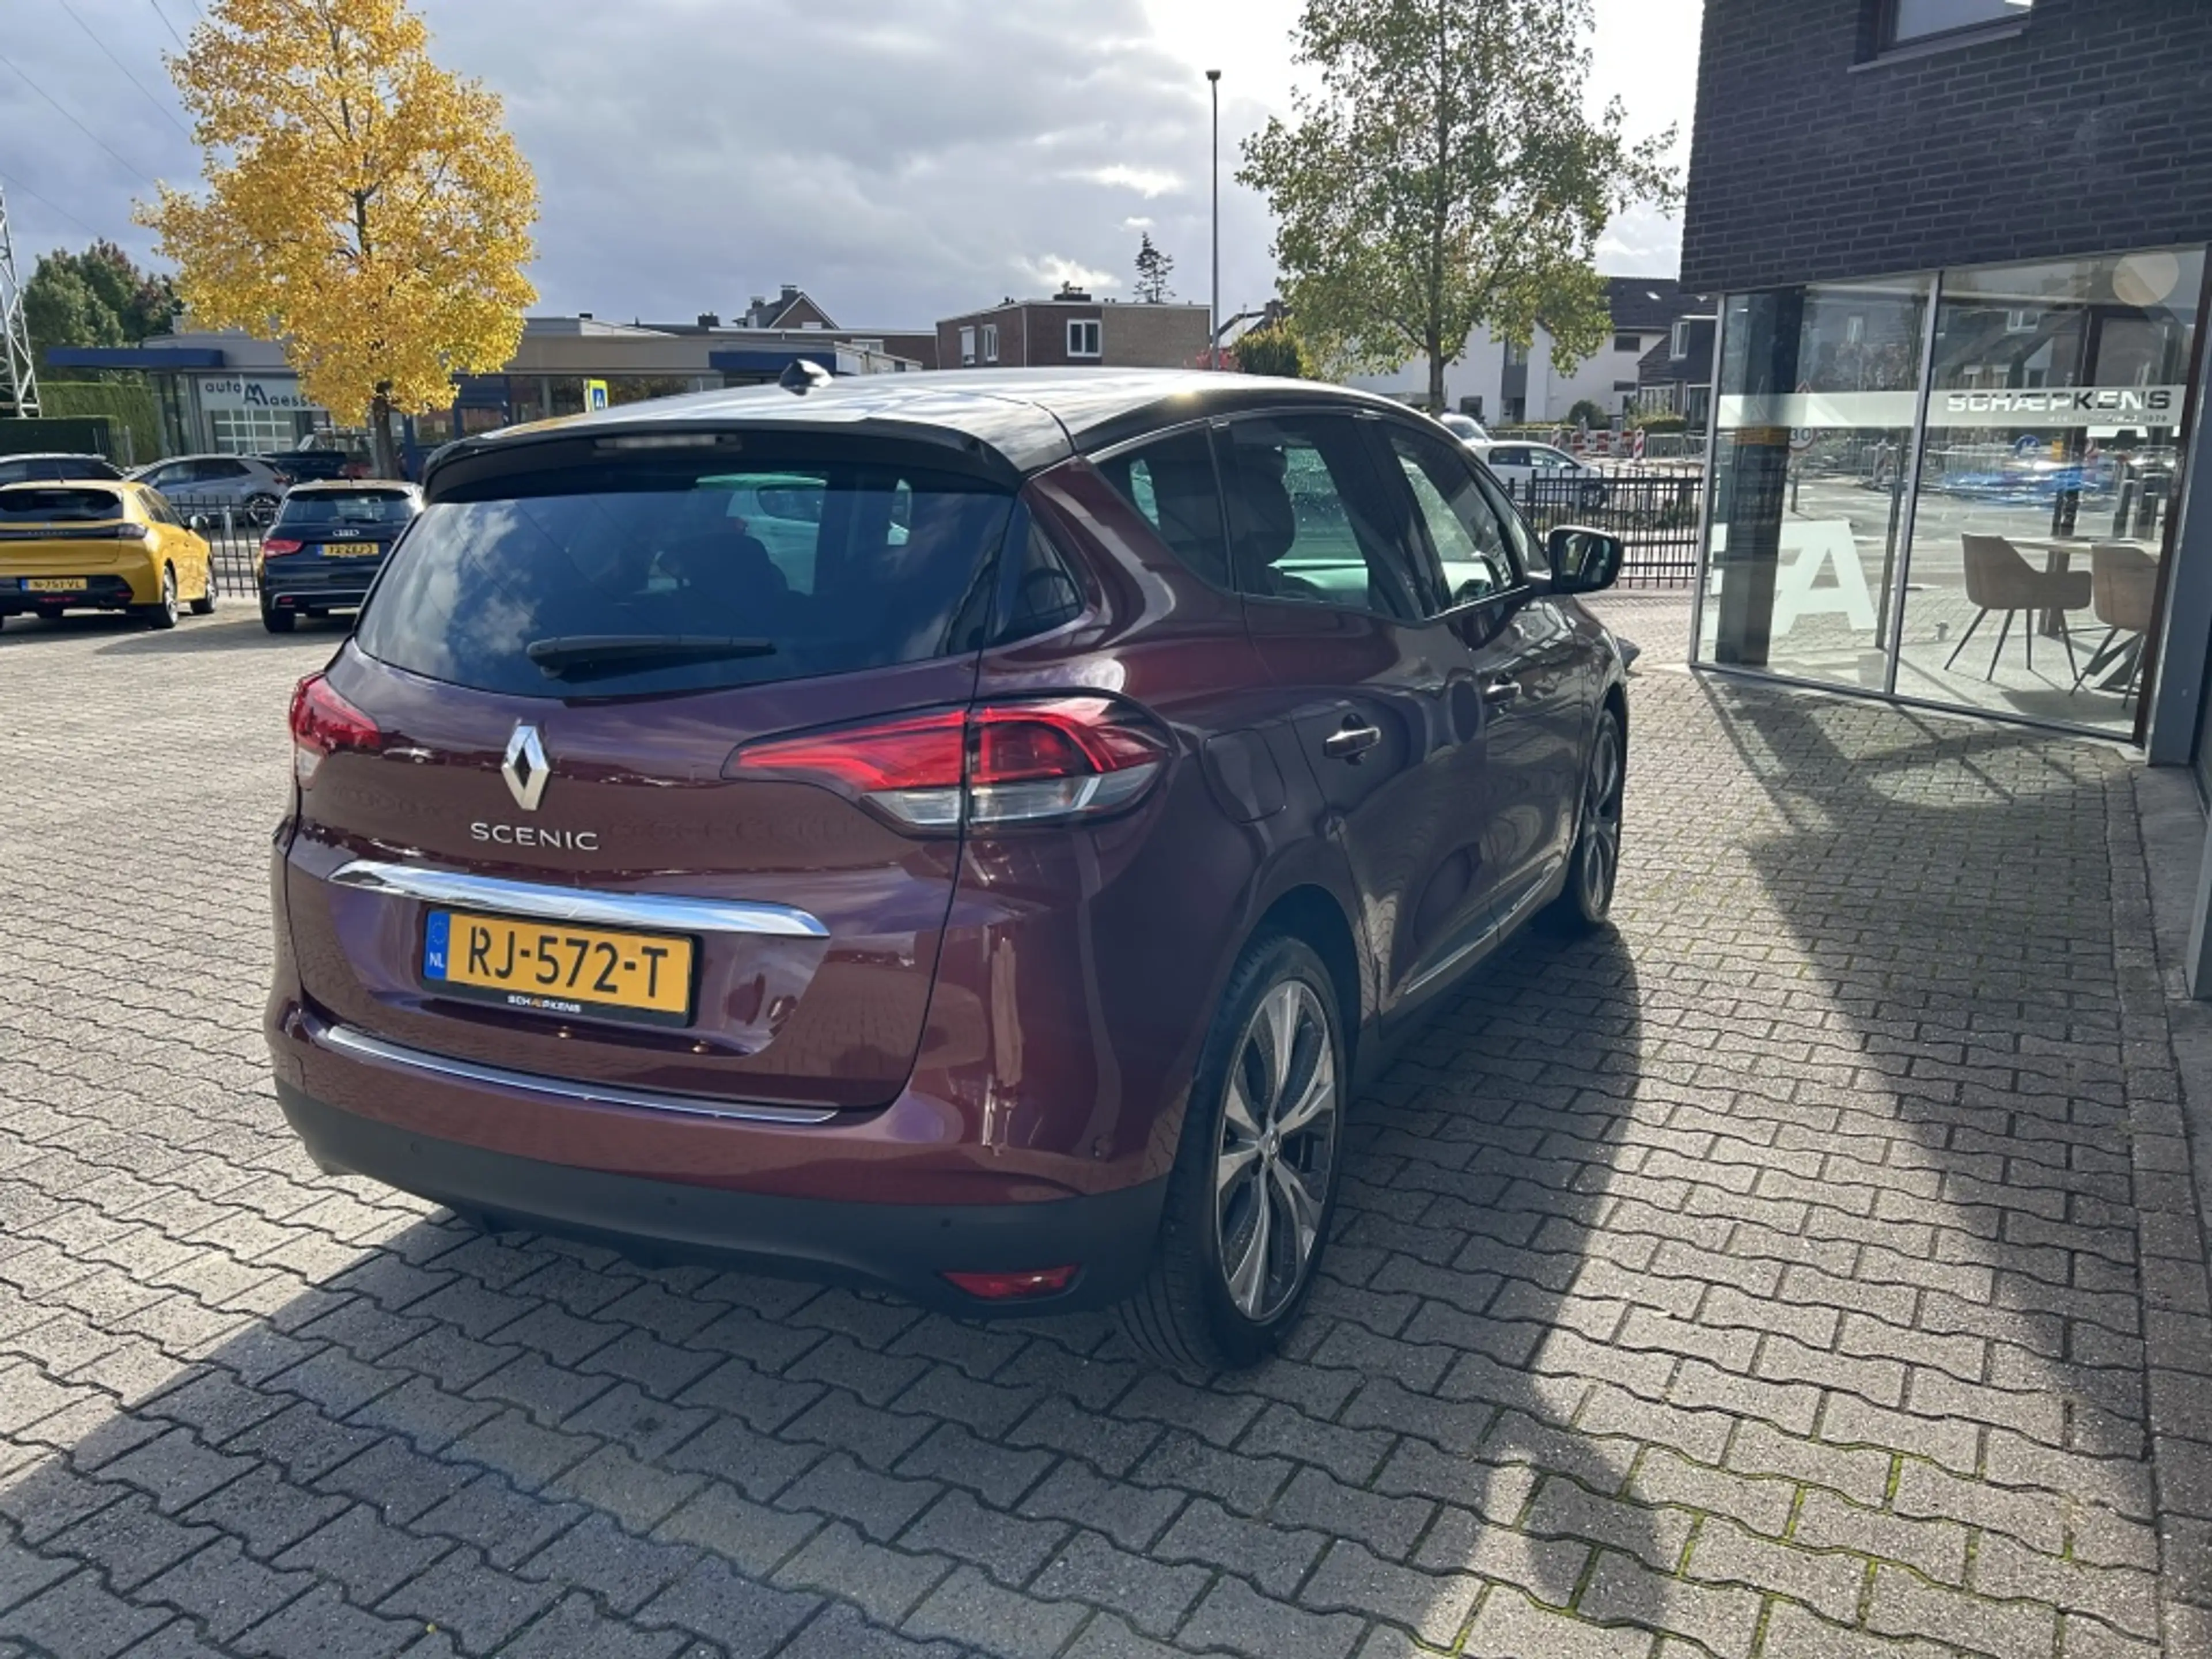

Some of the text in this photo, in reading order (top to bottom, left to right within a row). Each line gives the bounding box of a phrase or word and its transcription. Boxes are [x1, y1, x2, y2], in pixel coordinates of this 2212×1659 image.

[205, 380, 242, 393] auto
[470, 822, 599, 850] SCENIC
[429, 925, 668, 998] NL RJ-572-T
